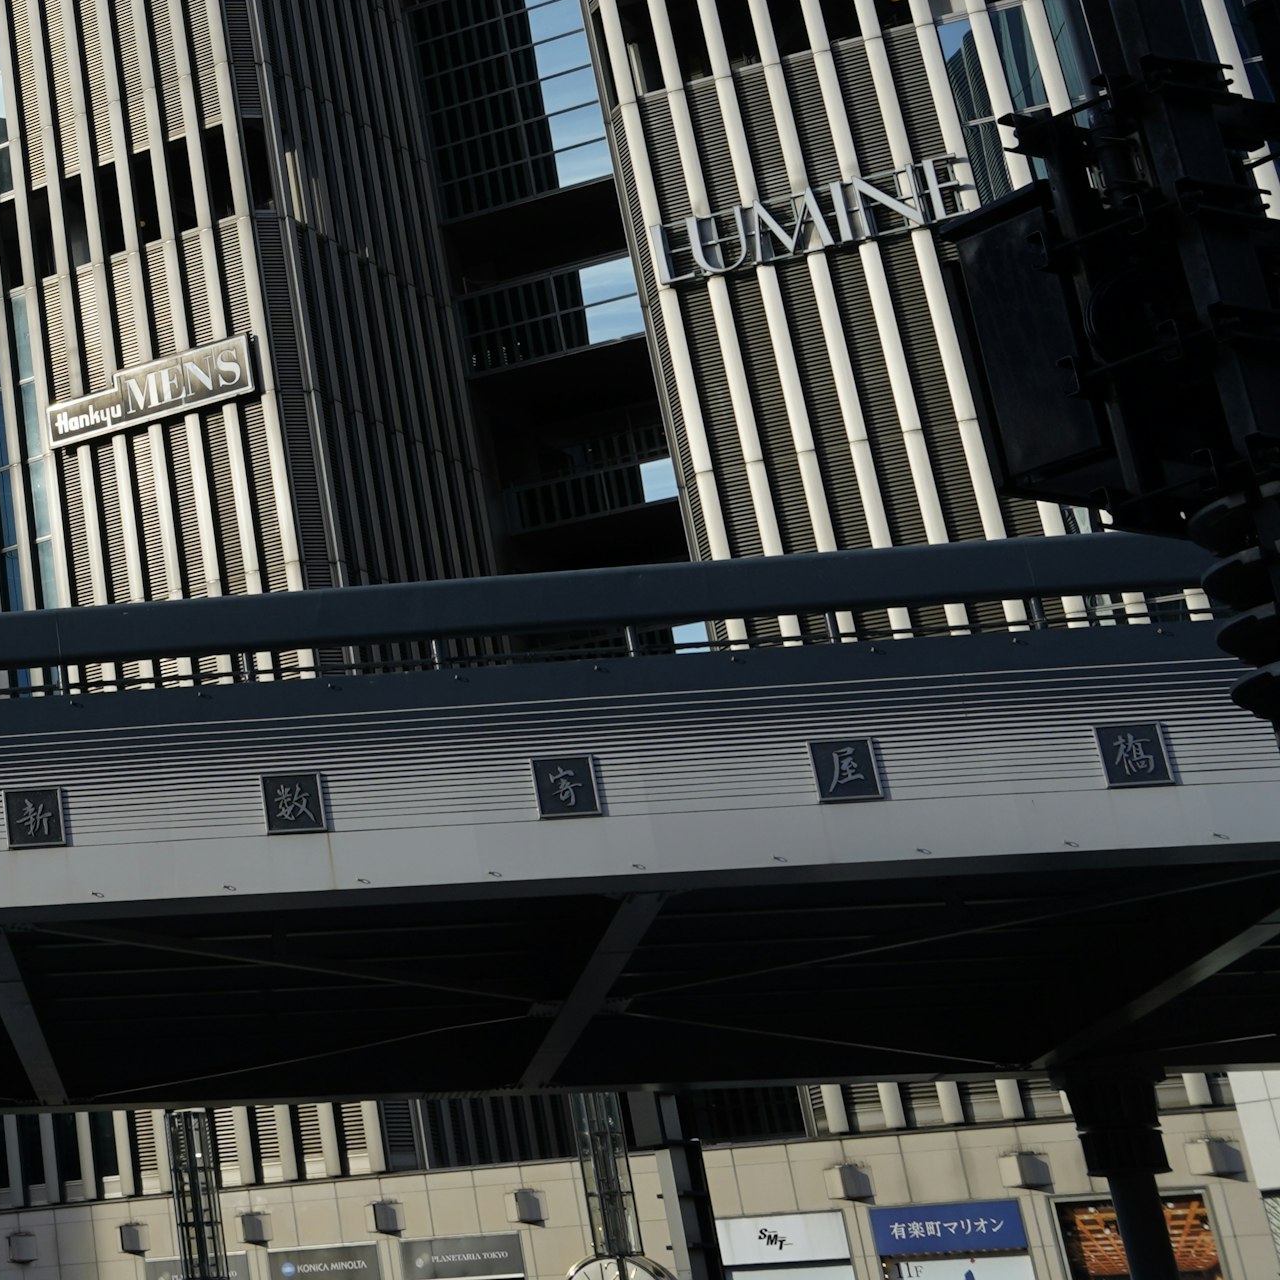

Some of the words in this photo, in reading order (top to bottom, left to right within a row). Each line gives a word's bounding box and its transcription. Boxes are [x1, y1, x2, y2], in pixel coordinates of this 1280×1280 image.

[649, 153, 970, 286] LUMINE
[55, 403, 122, 435] Hankyu
[124, 347, 242, 415] MENS
[889, 1218, 1004, 1240] 有楽町マリオン
[297, 1263, 329, 1273] KONICA
[330, 1260, 367, 1271] MINOLTA
[431, 1252, 481, 1263] PLANETARIA
[482, 1251, 508, 1259] TOKYO
